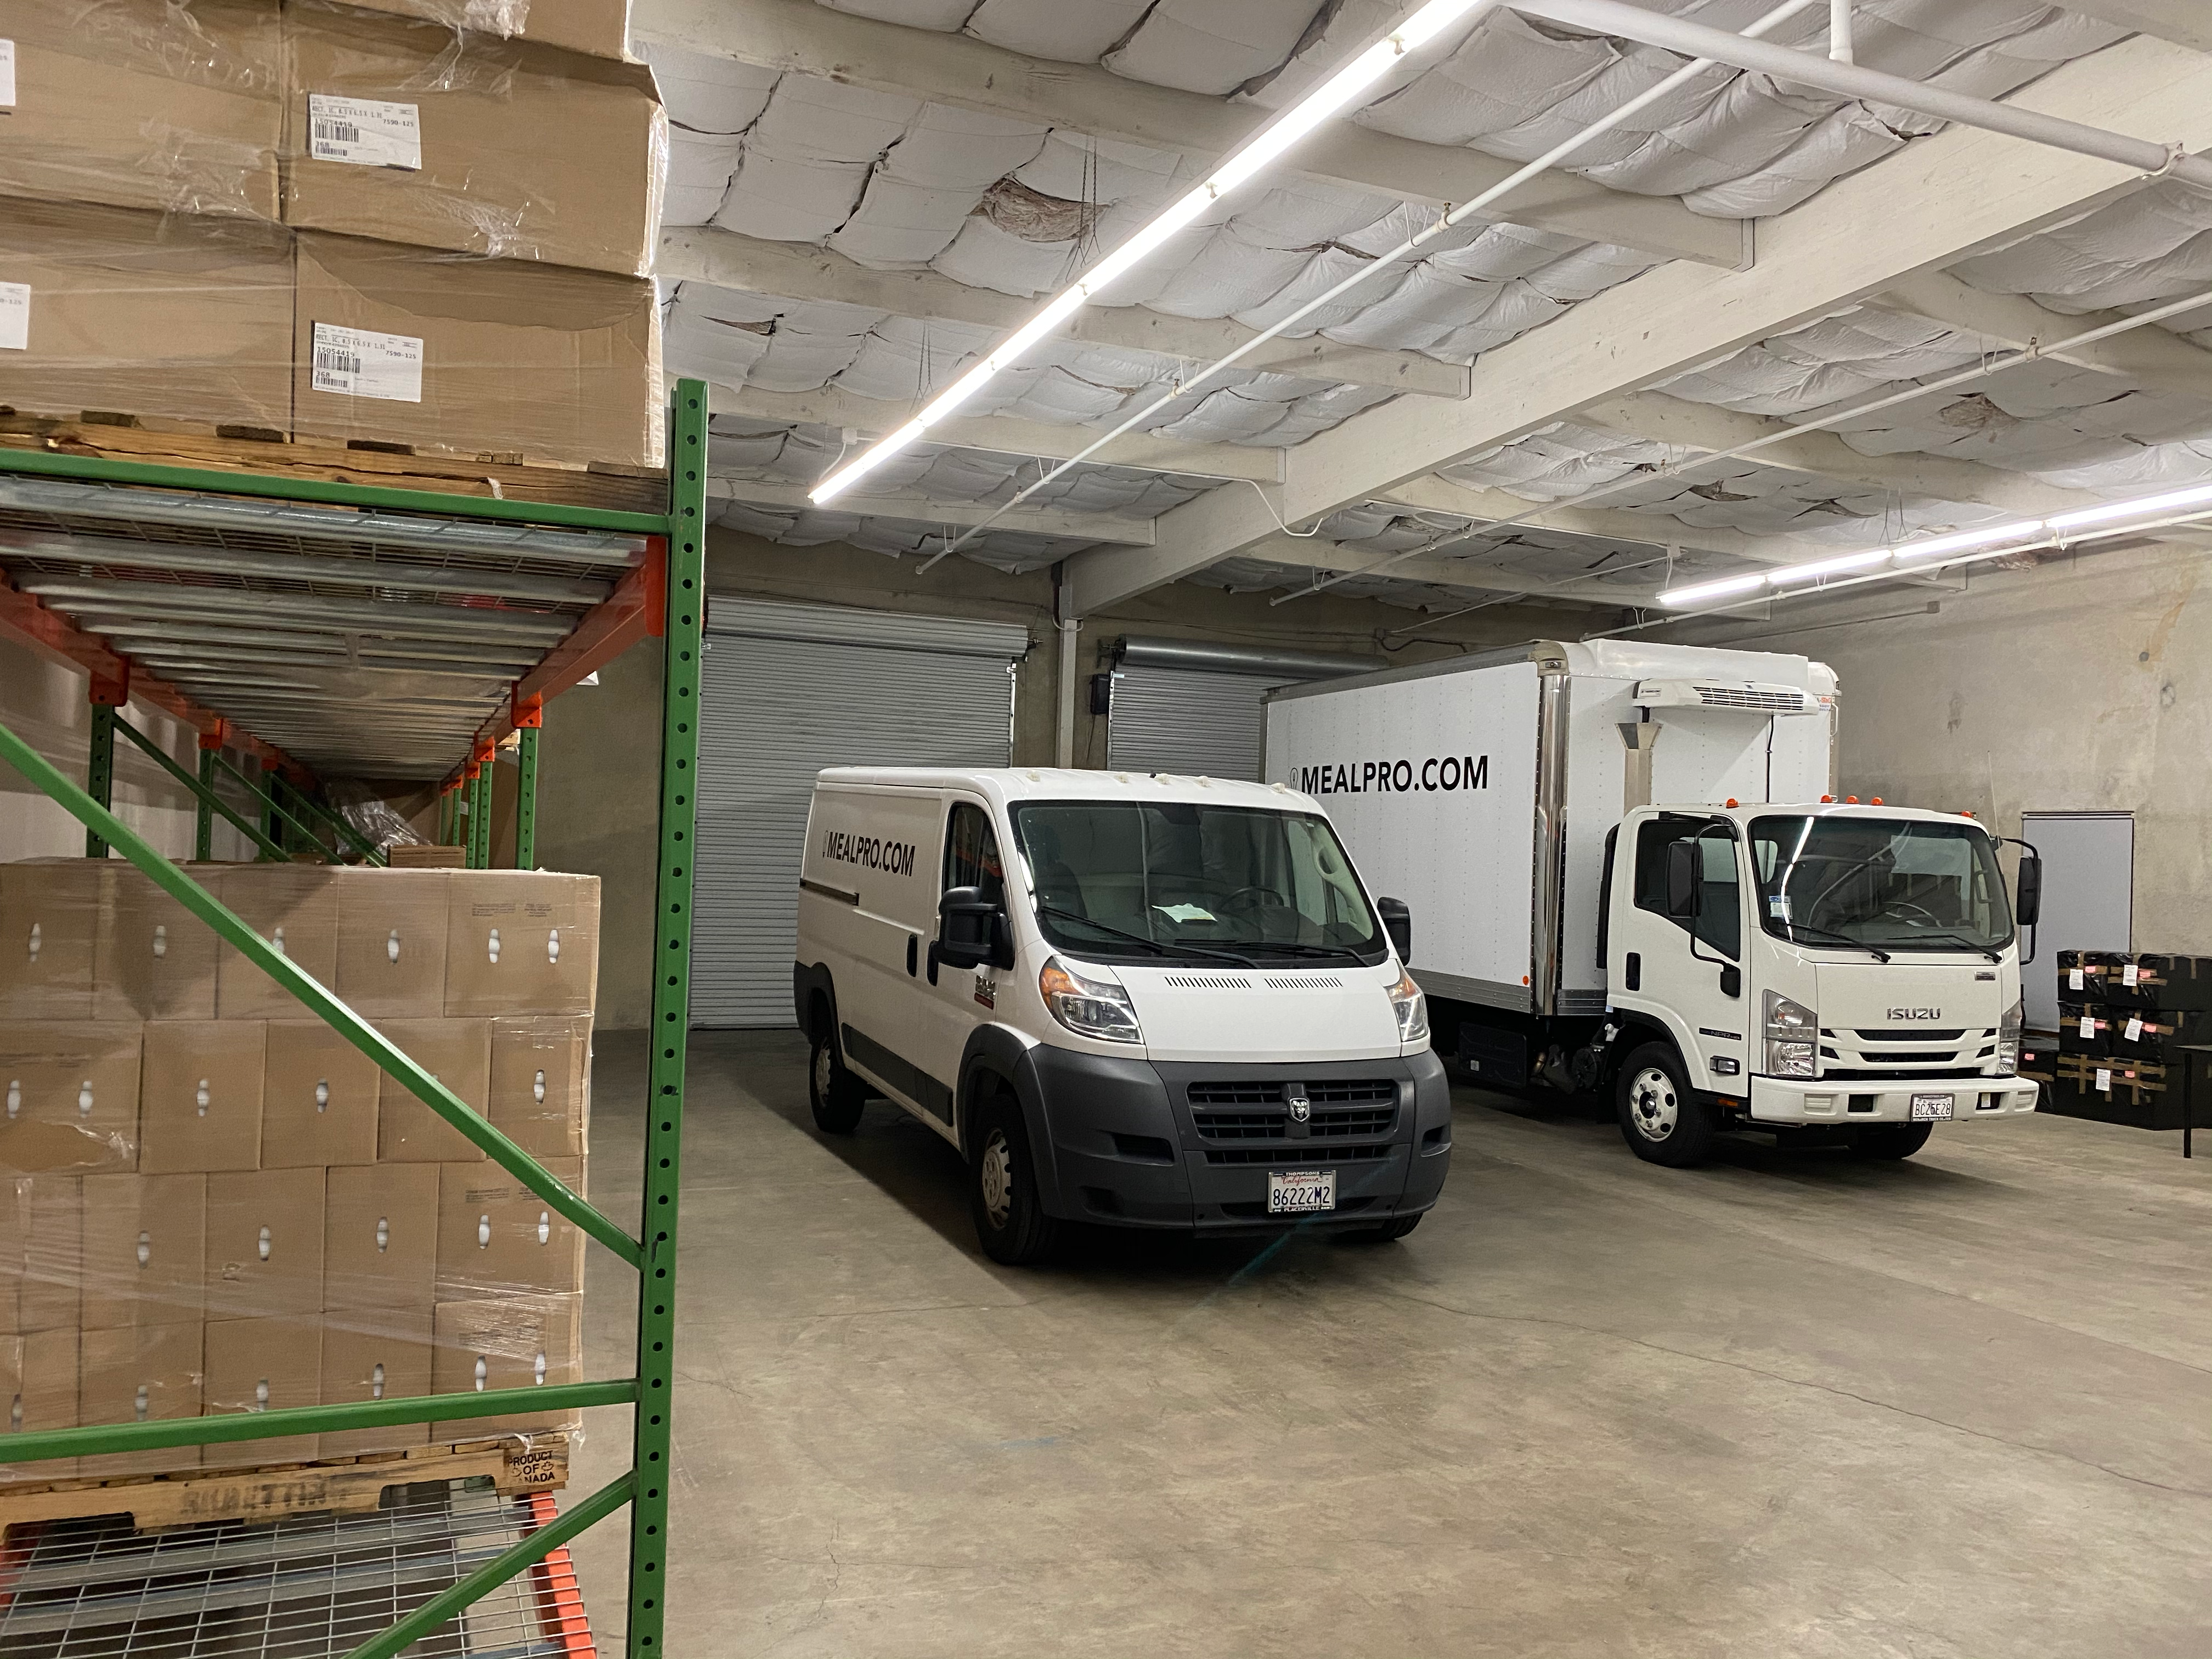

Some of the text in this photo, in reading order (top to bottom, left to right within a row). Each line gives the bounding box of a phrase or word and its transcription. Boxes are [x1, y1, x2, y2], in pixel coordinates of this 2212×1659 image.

[317, 346, 355, 358] 15054419
[386, 350, 416, 359] 7590-125
[316, 370, 330, 379] 368
[1301, 755, 1488, 795] MEALPRO.COM
[827, 831, 916, 877] MEALPRO.COM
[1887, 1008, 1940, 1020] ISUZU
[1282, 1176, 1322, 1187] California
[1273, 1186, 1330, 1206] 86222M2
[507, 1451, 553, 1467] PRODUCT
[523, 1464, 540, 1475] OF
